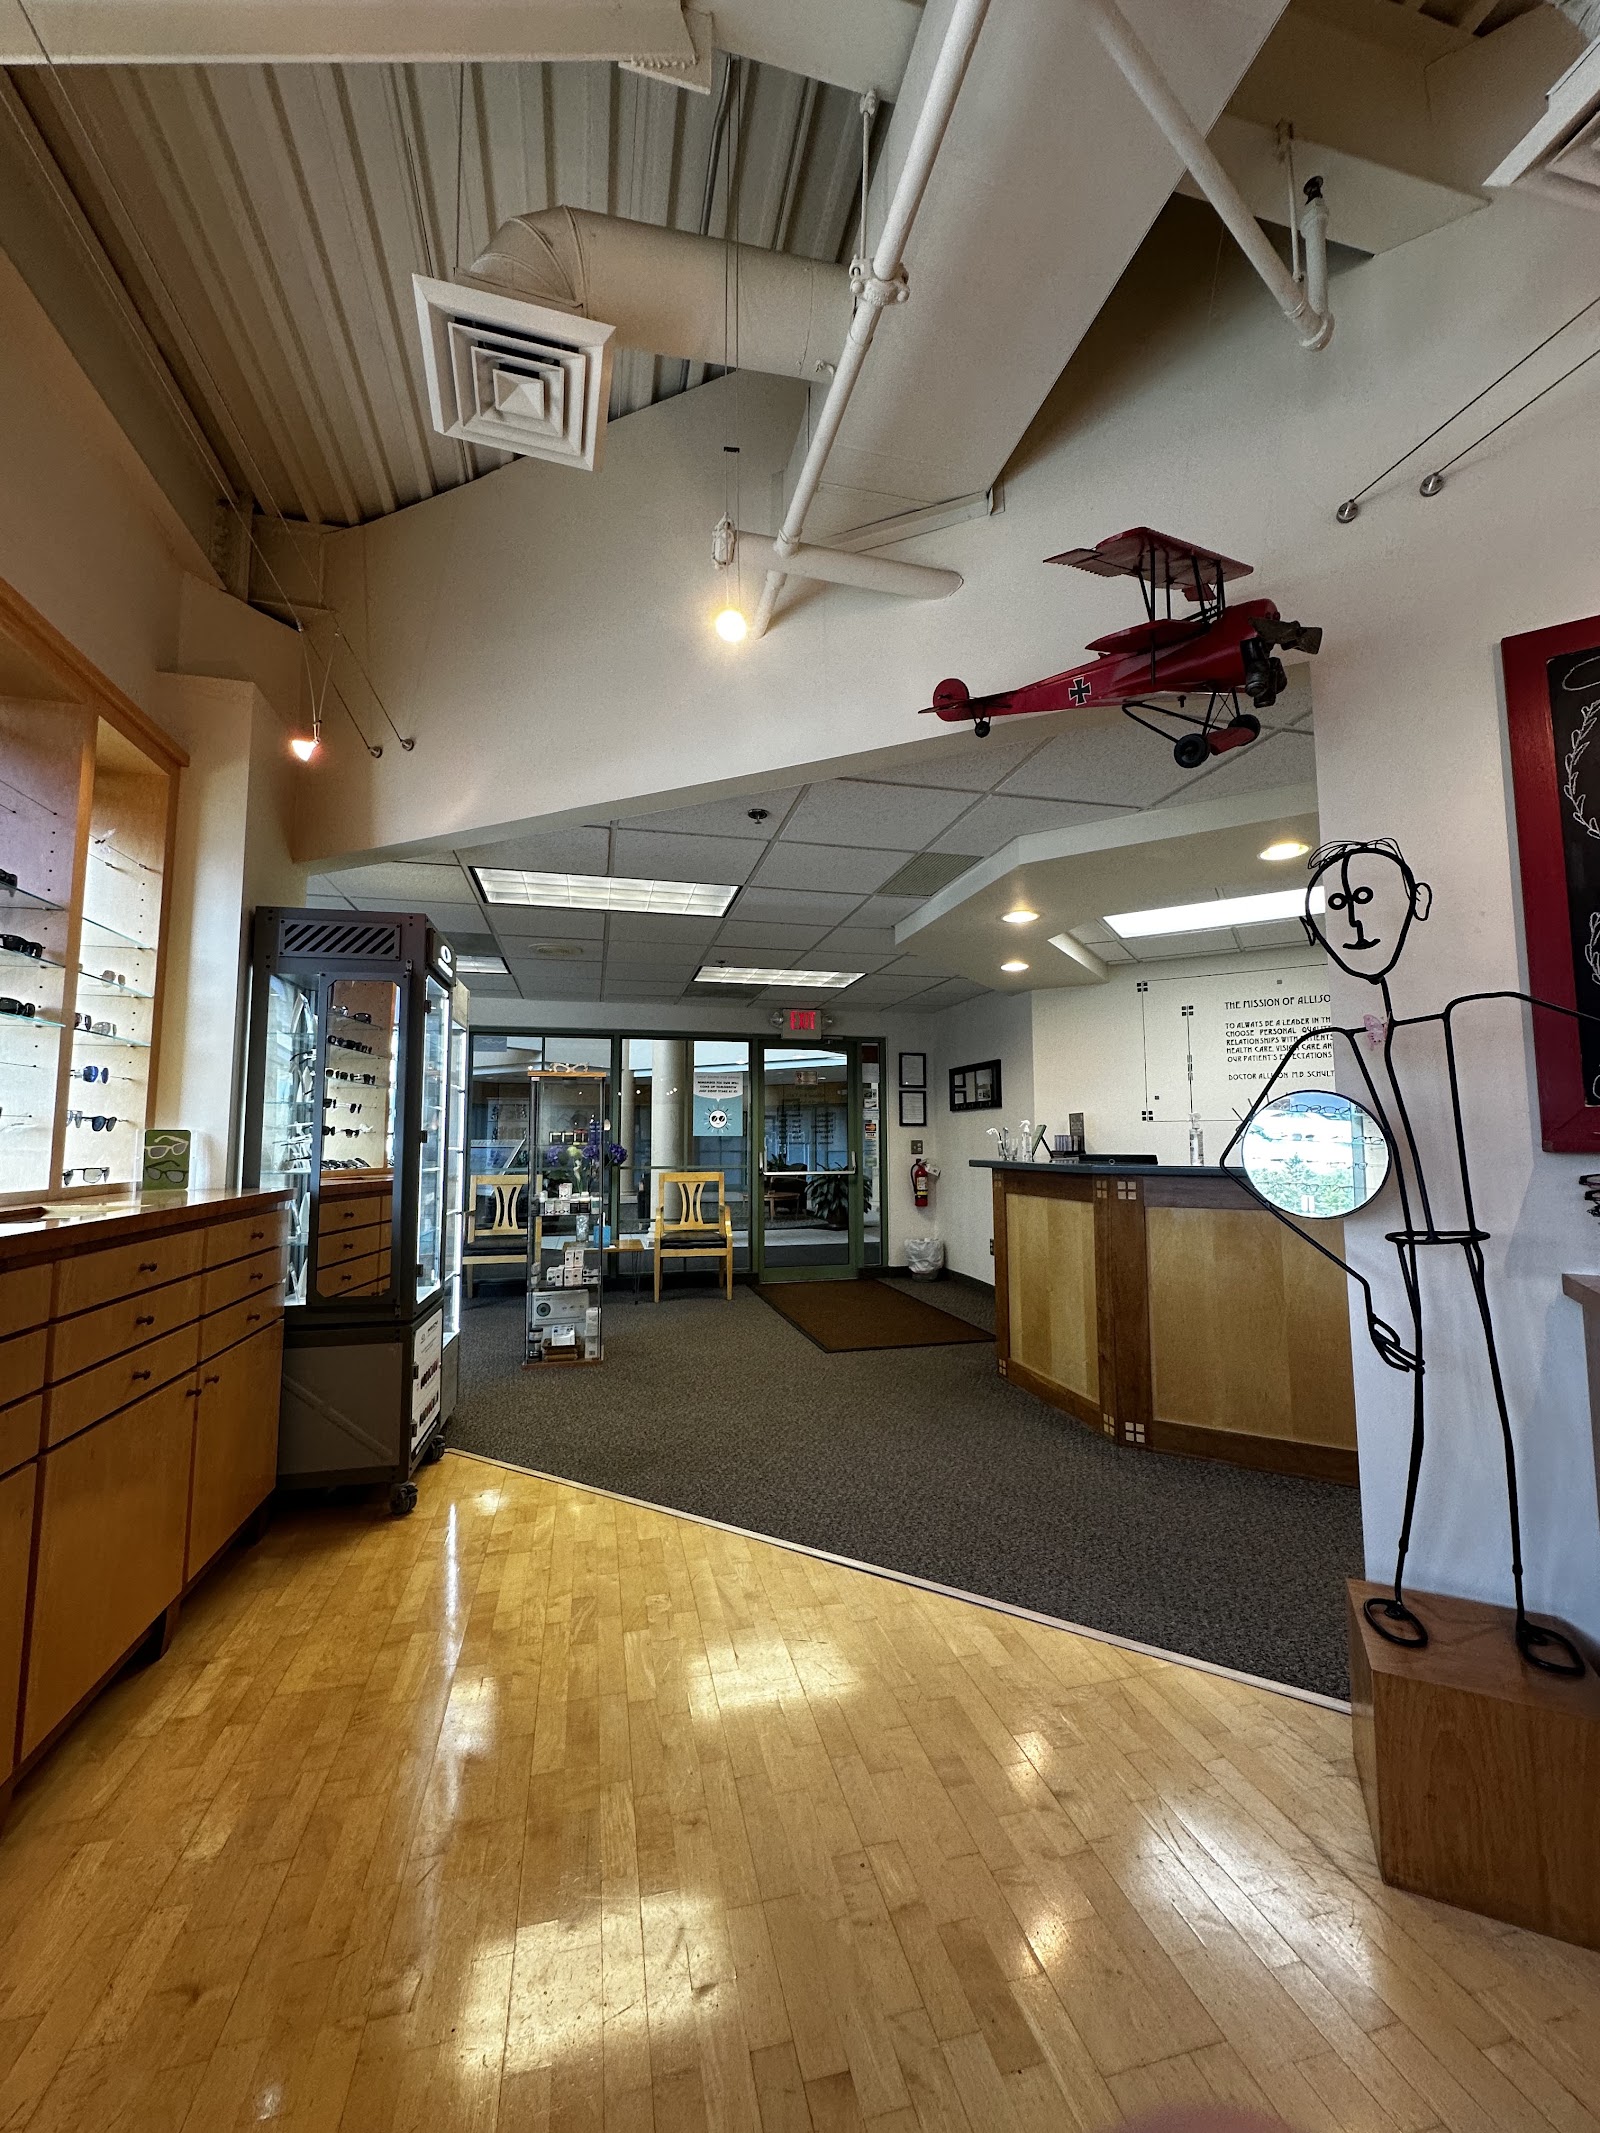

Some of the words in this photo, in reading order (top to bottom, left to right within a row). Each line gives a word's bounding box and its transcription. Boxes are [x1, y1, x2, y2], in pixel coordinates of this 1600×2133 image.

[1225, 1001, 1241, 1010] THE
[1243, 998, 1280, 1008] MISSION
[1282, 996, 1295, 1005] OF
[791, 1011, 816, 1030] EXIT
[1236, 1020, 1263, 1029] ALWAYS
[1282, 1017, 1310, 1026] LEADER
[1225, 1029, 1255, 1037] CHOOSE
[1259, 1027, 1297, 1036] PERSONAL
[1226, 1036, 1280, 1046] RELATIONSHIPS
[1226, 1046, 1253, 1054] HEALTH
[1301, 1042, 1321, 1051] CARE
[1227, 1055, 1242, 1063] OUR
[1243, 1053, 1278, 1062] PATIENT'S
[1228, 1073, 1257, 1081] DOCTOR
[1258, 1071, 1289, 1080] ALLION
